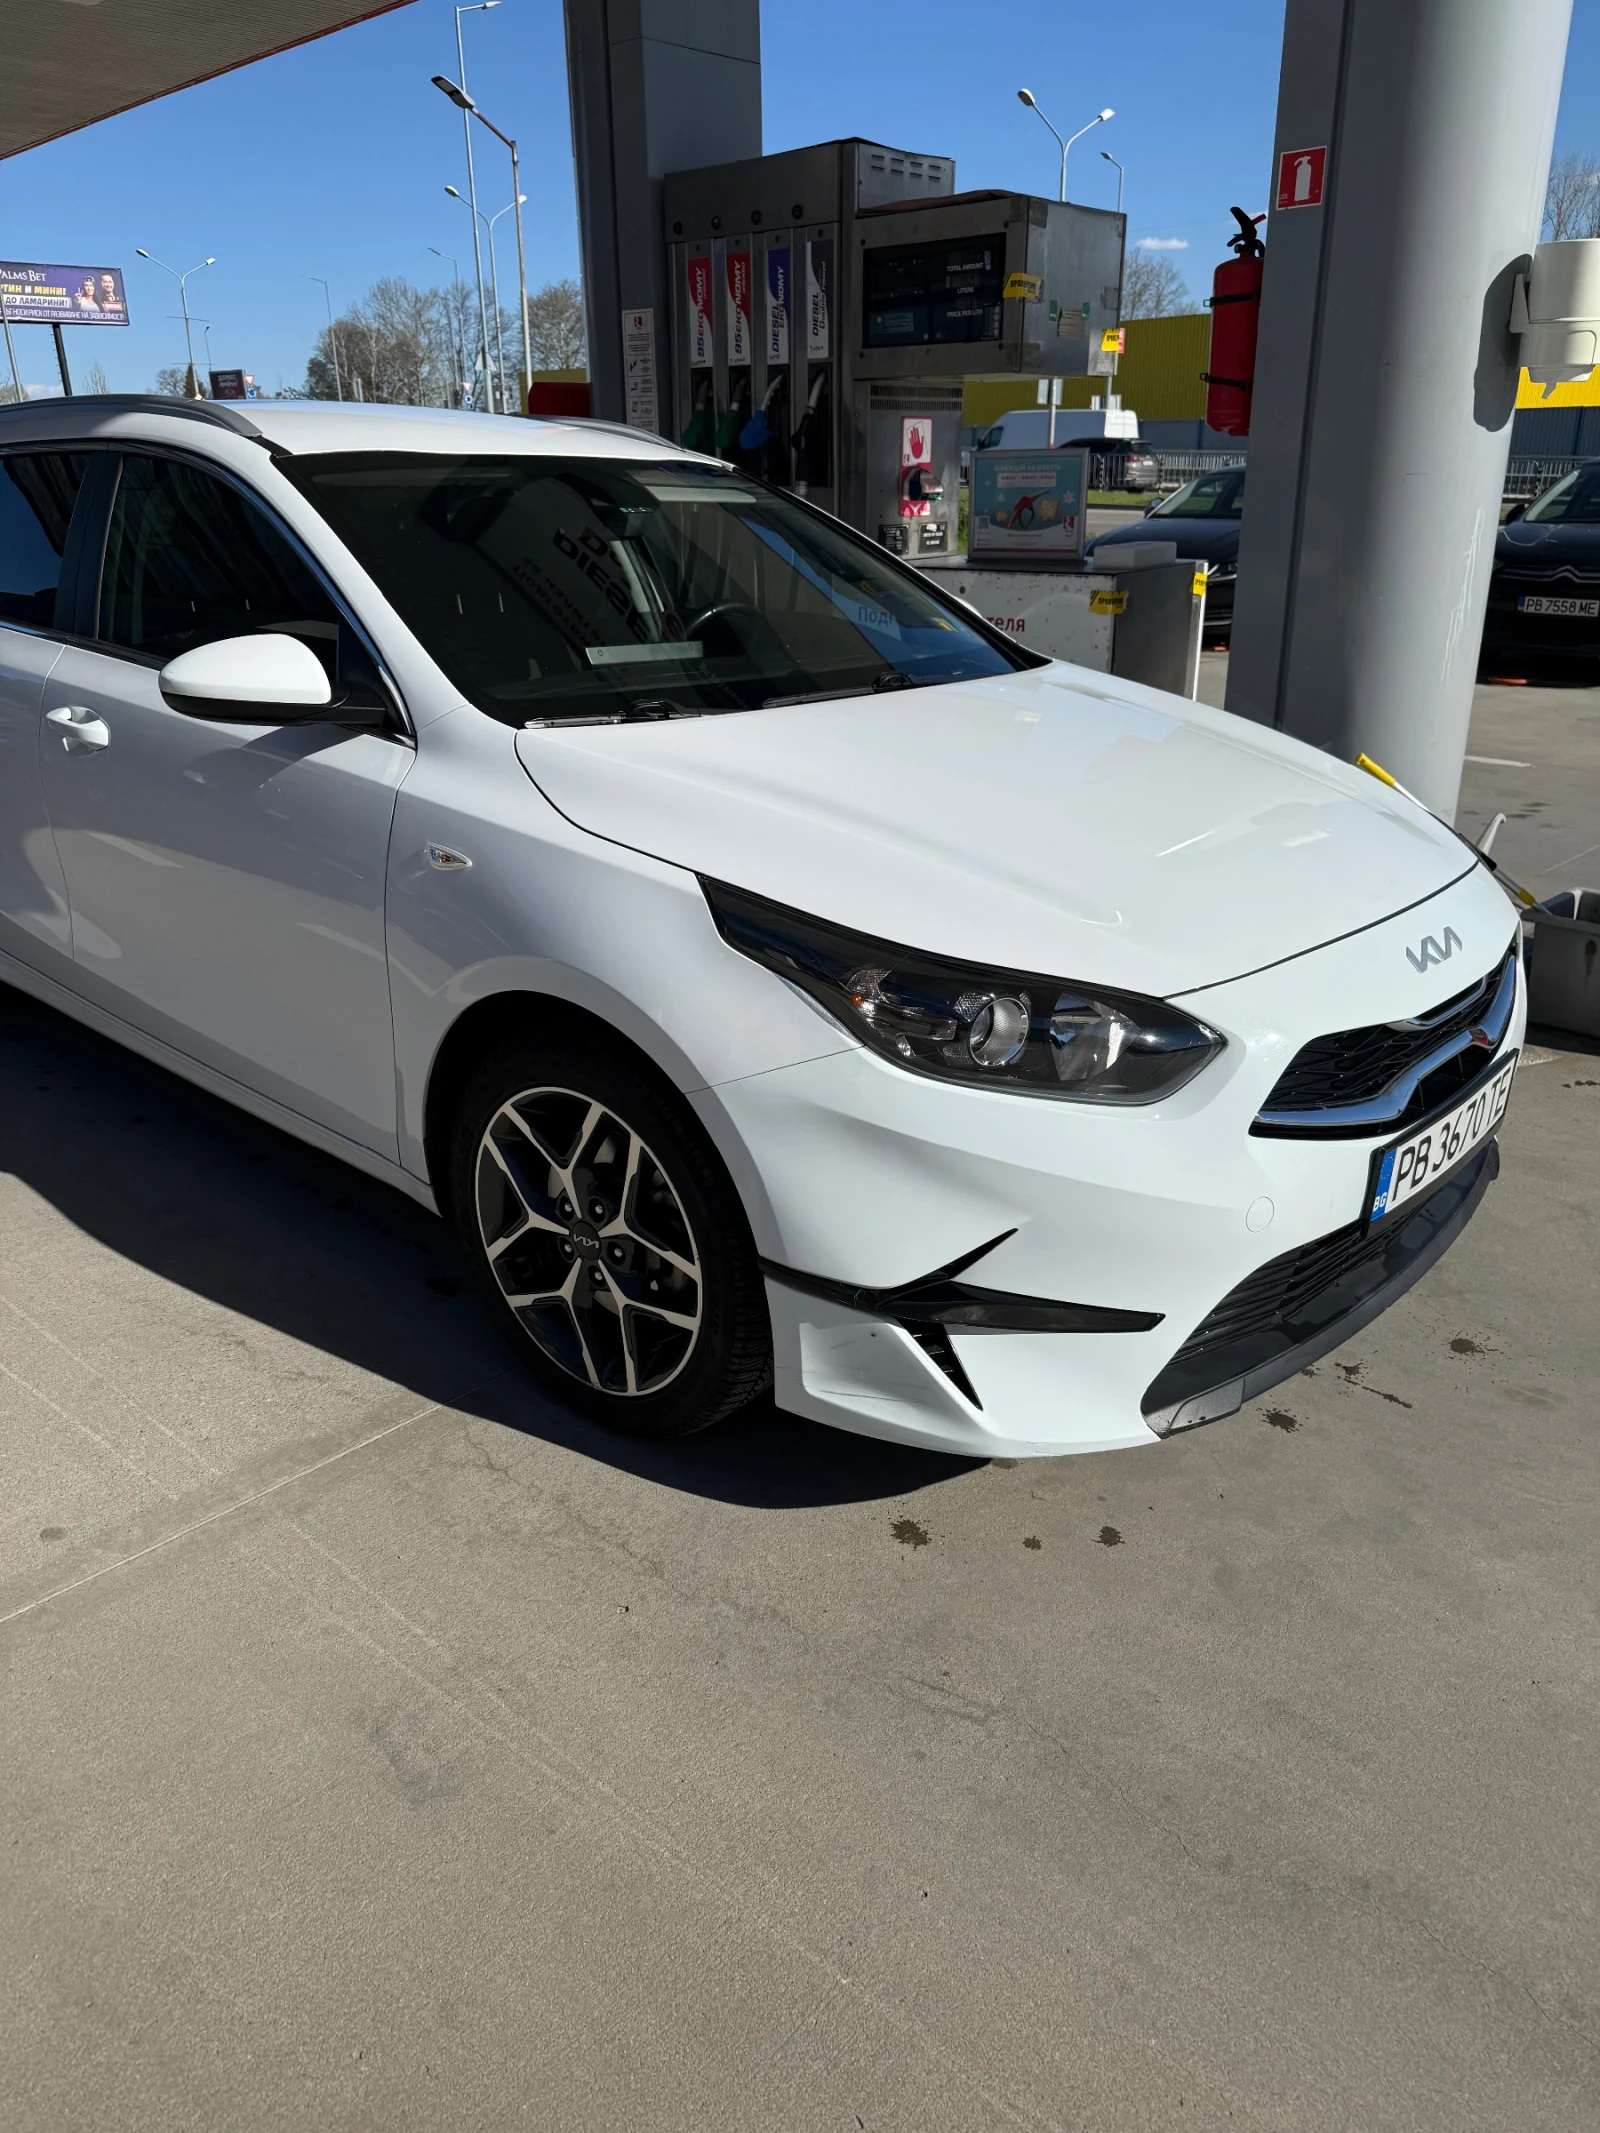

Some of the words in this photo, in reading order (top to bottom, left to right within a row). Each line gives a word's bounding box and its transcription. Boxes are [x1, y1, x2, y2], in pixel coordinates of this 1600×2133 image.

[947, 264, 962, 272] TOTAL
[962, 262, 984, 270] AMOUNT
[0, 284, 22, 292] ТИН
[25, 285, 31, 293] И
[34, 286, 66, 295] МИНИ!
[947, 310, 961, 318] PRICE
[962, 309, 972, 317] PER
[1526, 599, 1543, 611] PB
[1544, 600, 1577, 613] 7558
[1578, 602, 1597, 615] ME
[1392, 1135, 1432, 1202] PB
[1432, 1091, 1486, 1172] 3670
[1487, 1066, 1511, 1126] TE
[1373, 1192, 1388, 1211] BG
